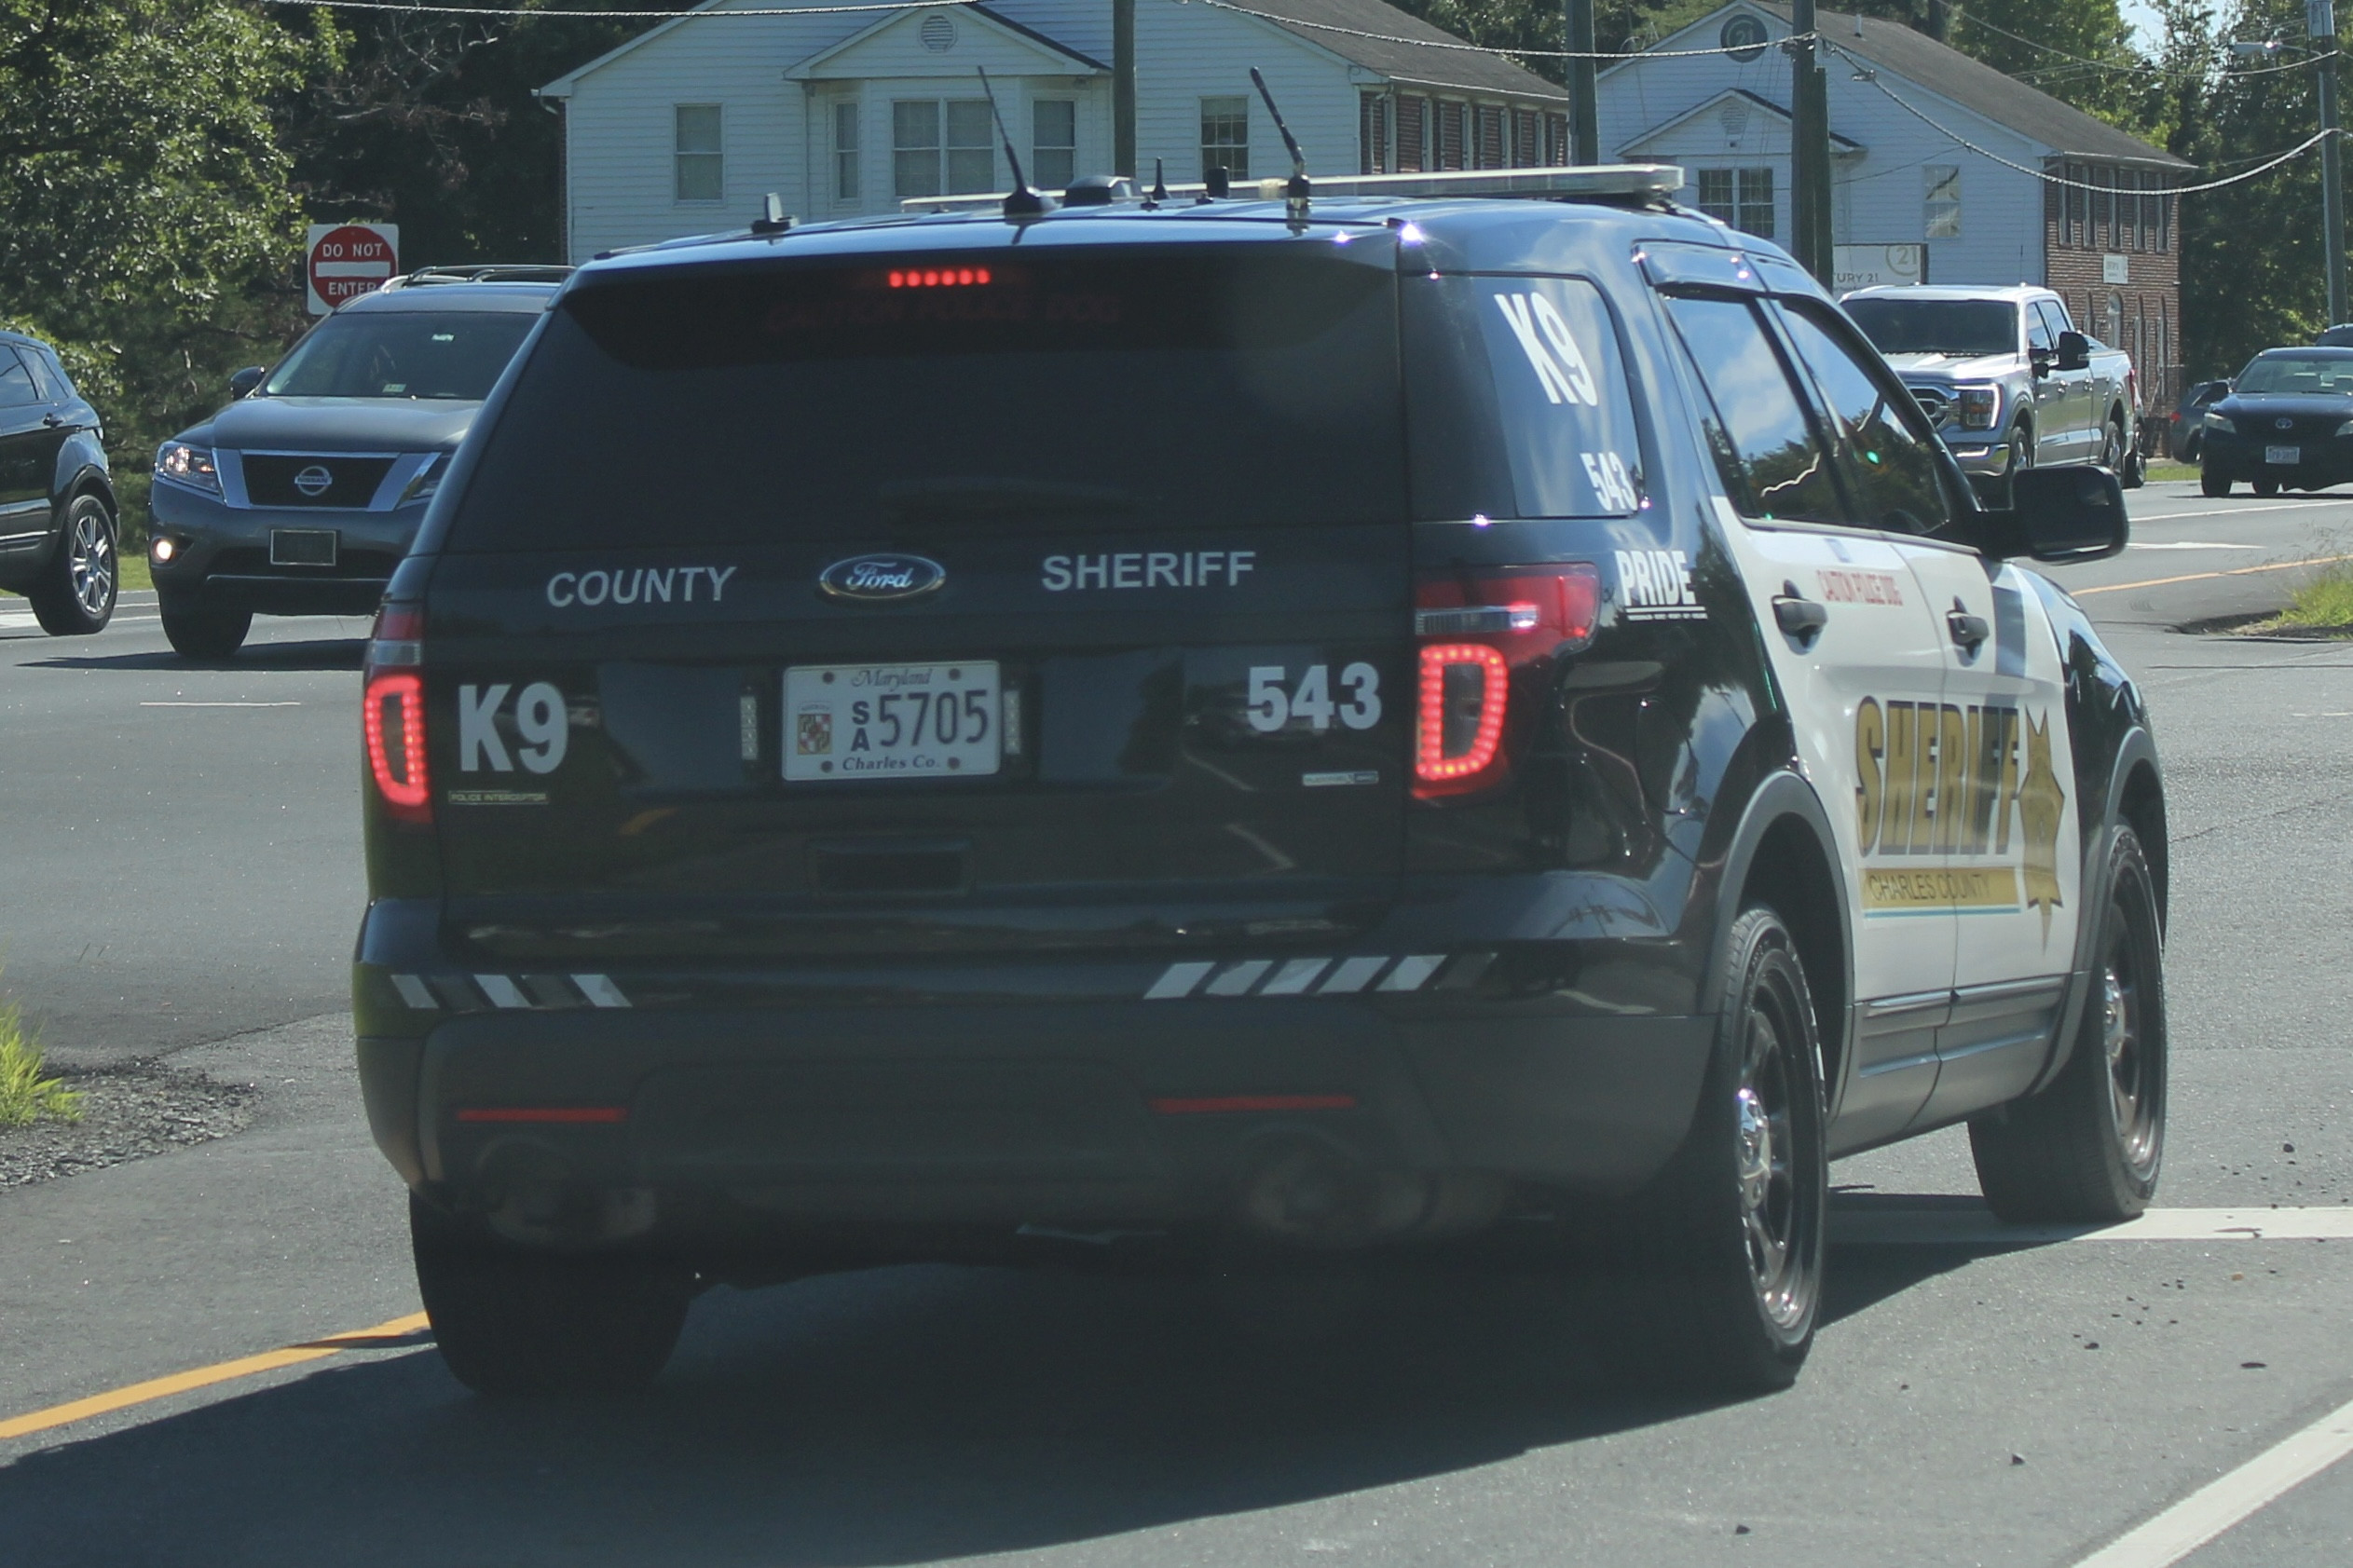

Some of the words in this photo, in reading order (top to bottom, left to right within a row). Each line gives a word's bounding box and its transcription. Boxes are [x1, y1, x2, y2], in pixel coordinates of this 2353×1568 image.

[321, 243, 344, 257] DO
[352, 242, 383, 256] NOT
[328, 281, 376, 295] ENTER
[1867, 272, 1879, 282] 21
[1494, 292, 1598, 407] K9
[1580, 451, 1638, 511] 543
[546, 566, 737, 607] COUNTY
[845, 562, 913, 590] Ford
[1041, 551, 1256, 592] SHERIFF
[1614, 550, 1697, 607] PRIDE
[852, 668, 933, 692] Maryland
[1247, 661, 1382, 733] 543
[458, 681, 568, 774] K9
[879, 689, 988, 748] 5705
[842, 755, 907, 771] Charles
[1855, 696, 2020, 859] SHERIFF
[1867, 874, 1936, 902] CHARLES
[1937, 874, 1990, 900] COUNTY
